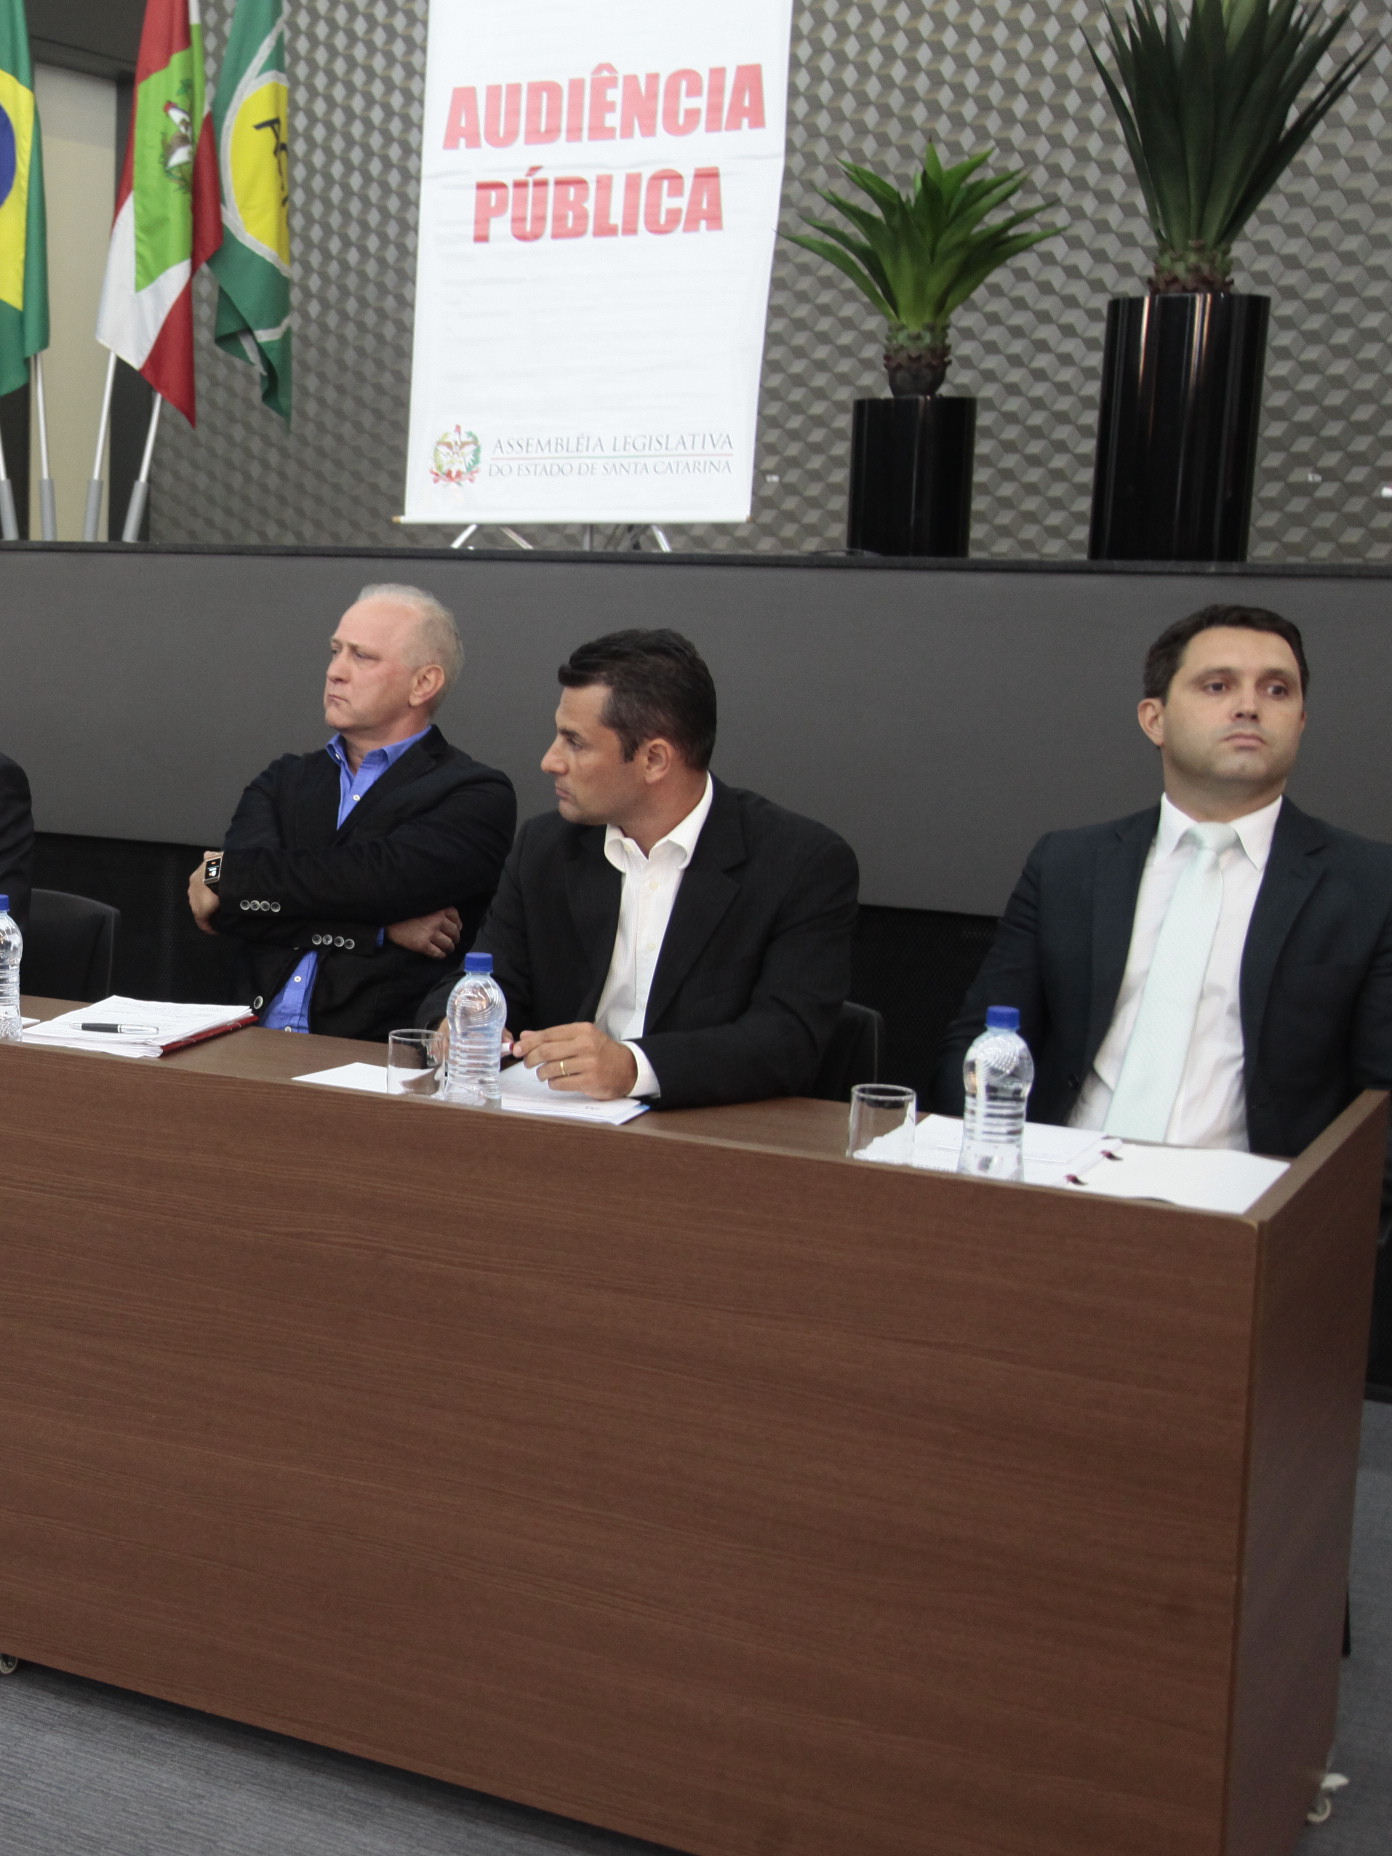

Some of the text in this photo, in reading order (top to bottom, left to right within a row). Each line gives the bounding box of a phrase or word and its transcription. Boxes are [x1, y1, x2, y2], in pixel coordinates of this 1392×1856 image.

[443, 62, 766, 150] AUDIÊNCIA
[473, 166, 723, 243] PÚBLICA
[488, 459, 732, 477] DO ESTADO DE SANTA CATARINA
[492, 432, 734, 455] ASSEMBLÉIA LEGISLATIVA
